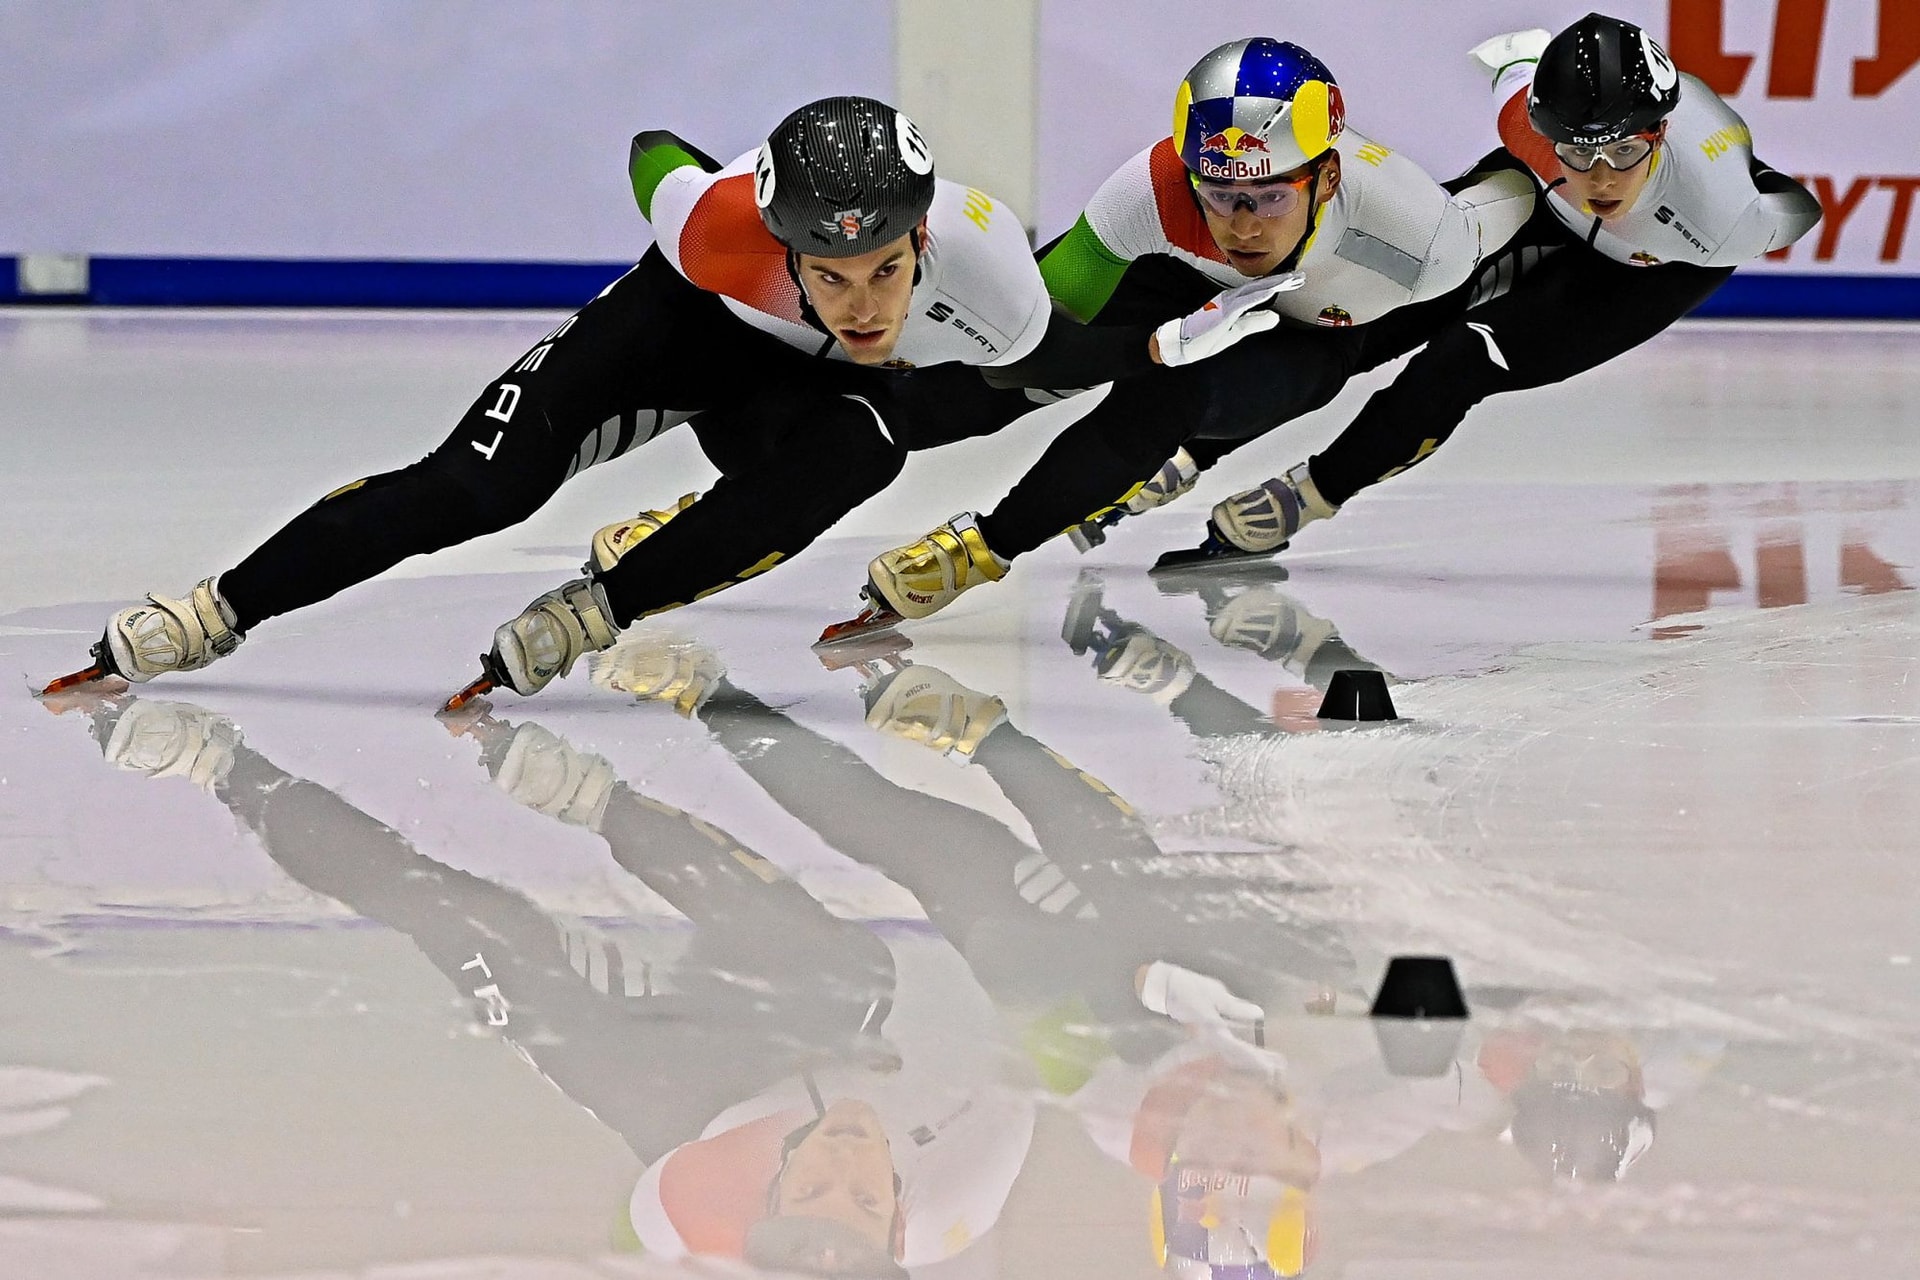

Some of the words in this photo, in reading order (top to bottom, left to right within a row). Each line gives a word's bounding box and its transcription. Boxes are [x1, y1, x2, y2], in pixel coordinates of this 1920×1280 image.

[1573, 130, 1622, 144] RUDY
[1200, 157, 1234, 179] Red
[1235, 157, 1272, 179] Bull
[1673, 221, 1710, 254] SEAT
[952, 318, 998, 354] SEAT
